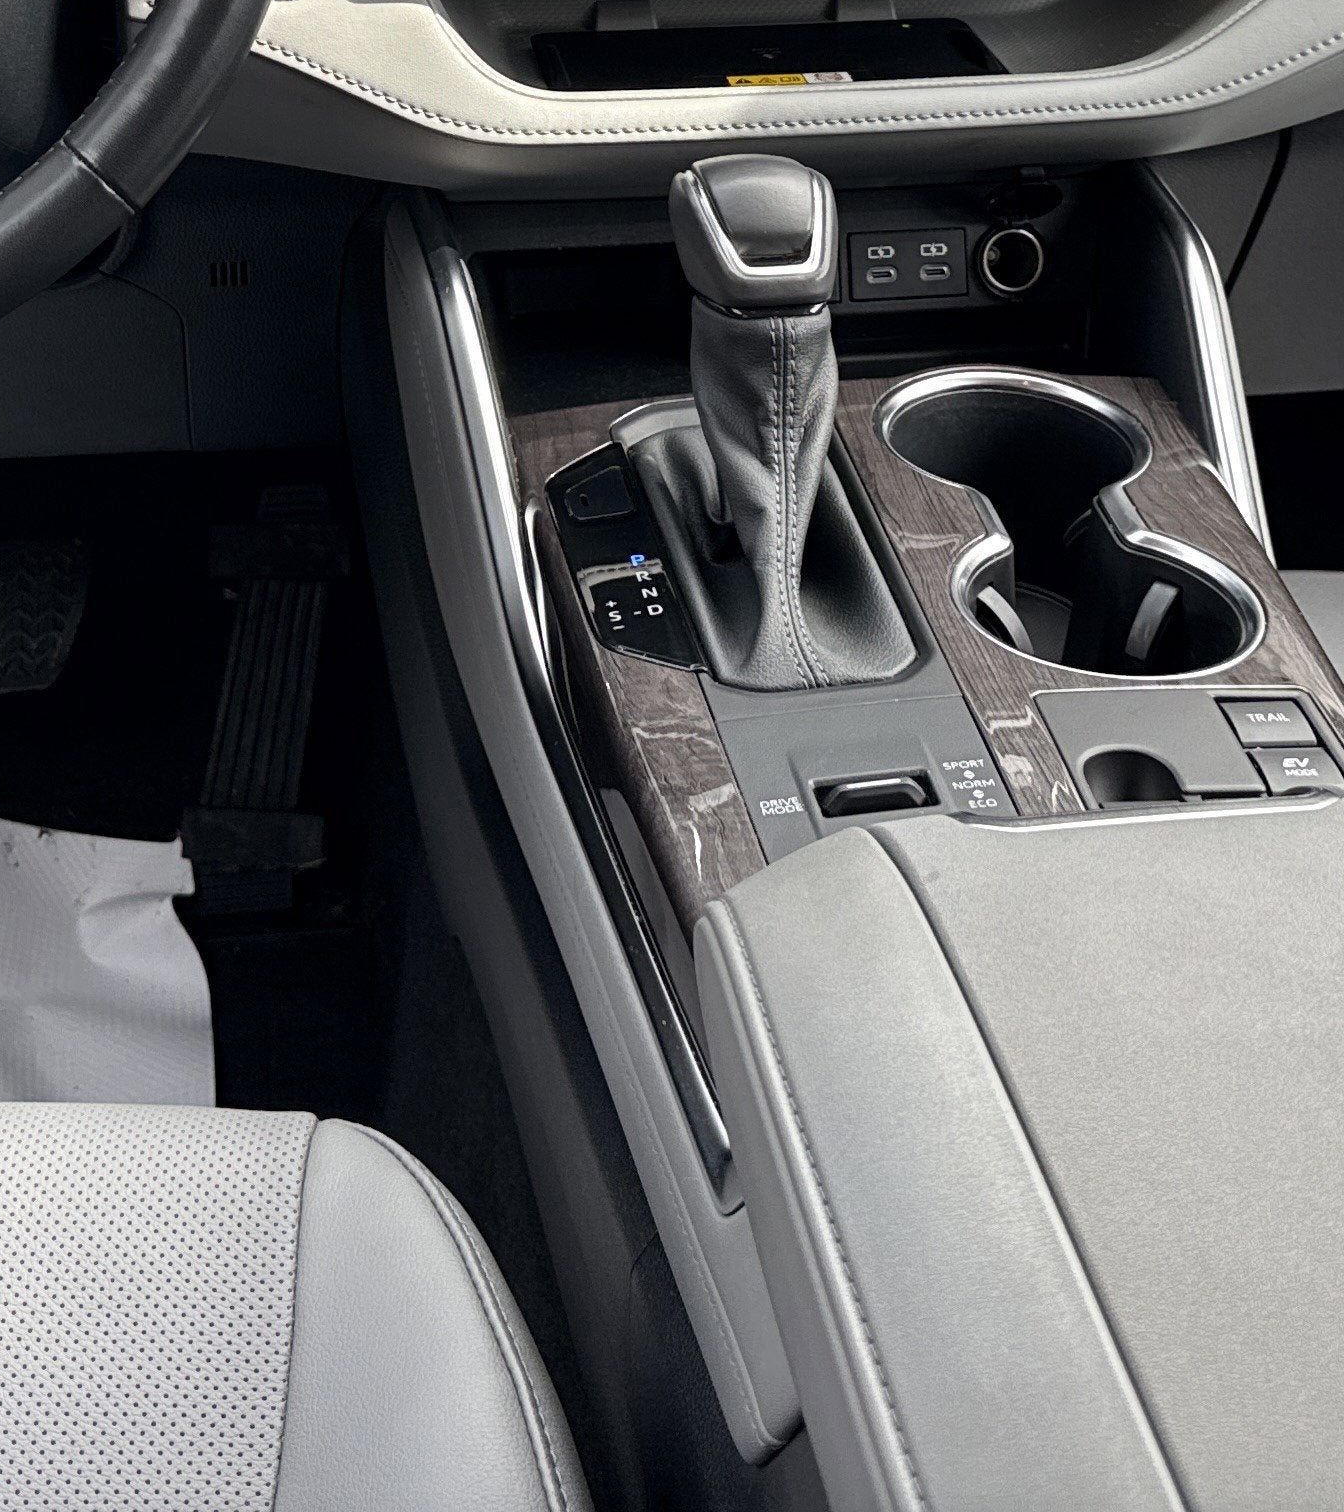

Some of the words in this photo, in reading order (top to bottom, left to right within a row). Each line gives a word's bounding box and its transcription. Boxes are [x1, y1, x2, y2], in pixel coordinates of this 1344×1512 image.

[630, 554, 645, 567] P
[636, 571, 653, 582] R
[641, 587, 659, 599] N
[647, 604, 664, 616] D
[608, 610, 622, 623] S
[1245, 712, 1291, 723] TRAIL
[942, 758, 985, 771] SPORT
[1282, 757, 1310, 768] EV
[1284, 768, 1319, 777] MODE
[951, 778, 996, 791] NORM
[759, 796, 799, 810] DRIVE
[968, 798, 998, 809] ECO
[761, 804, 804, 817] MODE
